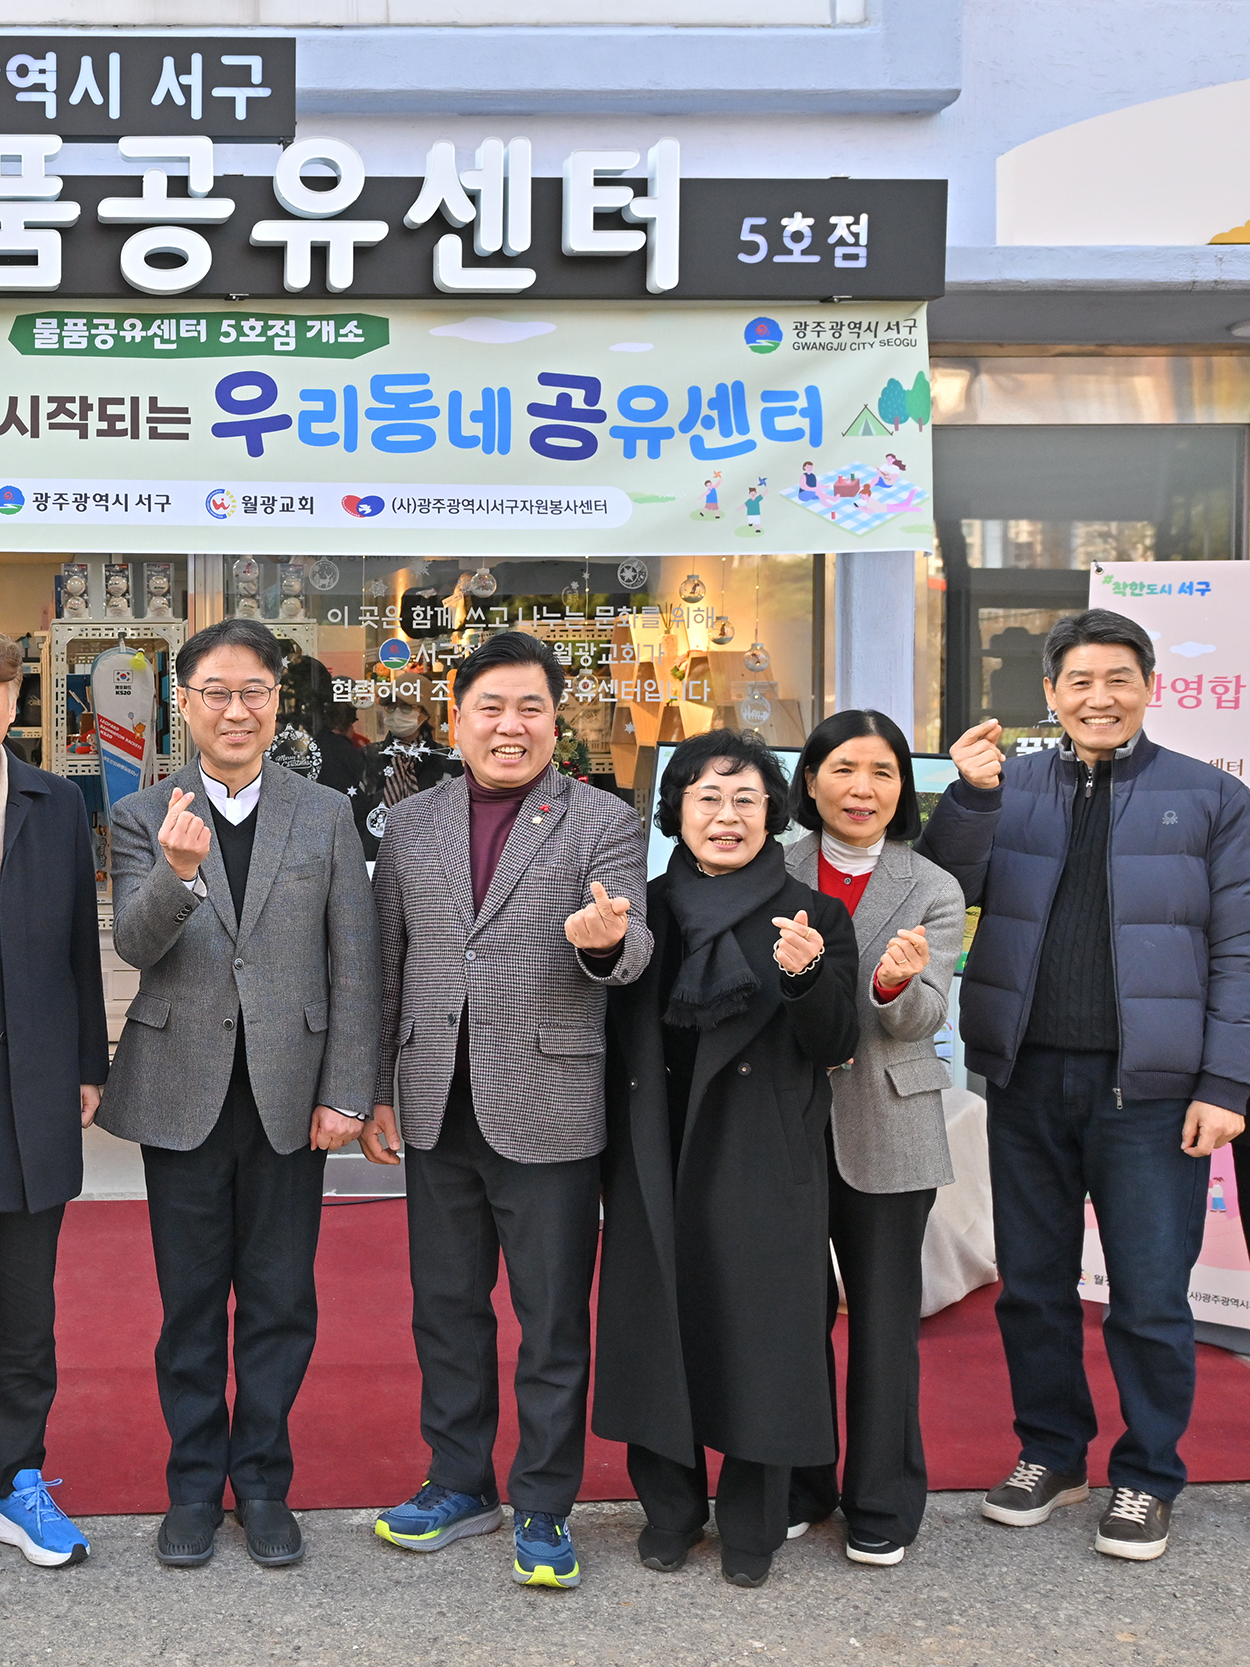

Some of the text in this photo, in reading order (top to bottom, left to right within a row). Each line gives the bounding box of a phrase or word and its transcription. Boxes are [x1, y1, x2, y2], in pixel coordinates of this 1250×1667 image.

[152, 52, 272, 121] 서구
[737, 211, 870, 269] 5호점
[32, 317, 366, 351] 물품공유센터 5호점 개소
[792, 318, 918, 339] 광주광역시 서구
[792, 338, 918, 351] GWANGJU CITY SEOGU
[211, 370, 512, 459] 우리동네
[526, 371, 824, 461] 공유센터
[32, 492, 172, 513] 광주광역시 서구
[241, 495, 314, 515] 월광교회
[391, 497, 608, 516] (사)광주광역시서구자원봉사센터
[1178, 581, 1212, 597] 서구
[327, 605, 715, 629] 이 곳은 함께 쓰고 나누는 문화를 위해
[553, 642, 665, 667] 월광교회가
[331, 679, 421, 703] 협력하여
[100, 718, 120, 731] LEOPARD
[100, 724, 142, 750] BADMINTON RACKETS
[1094, 1274, 1110, 1286] 월
